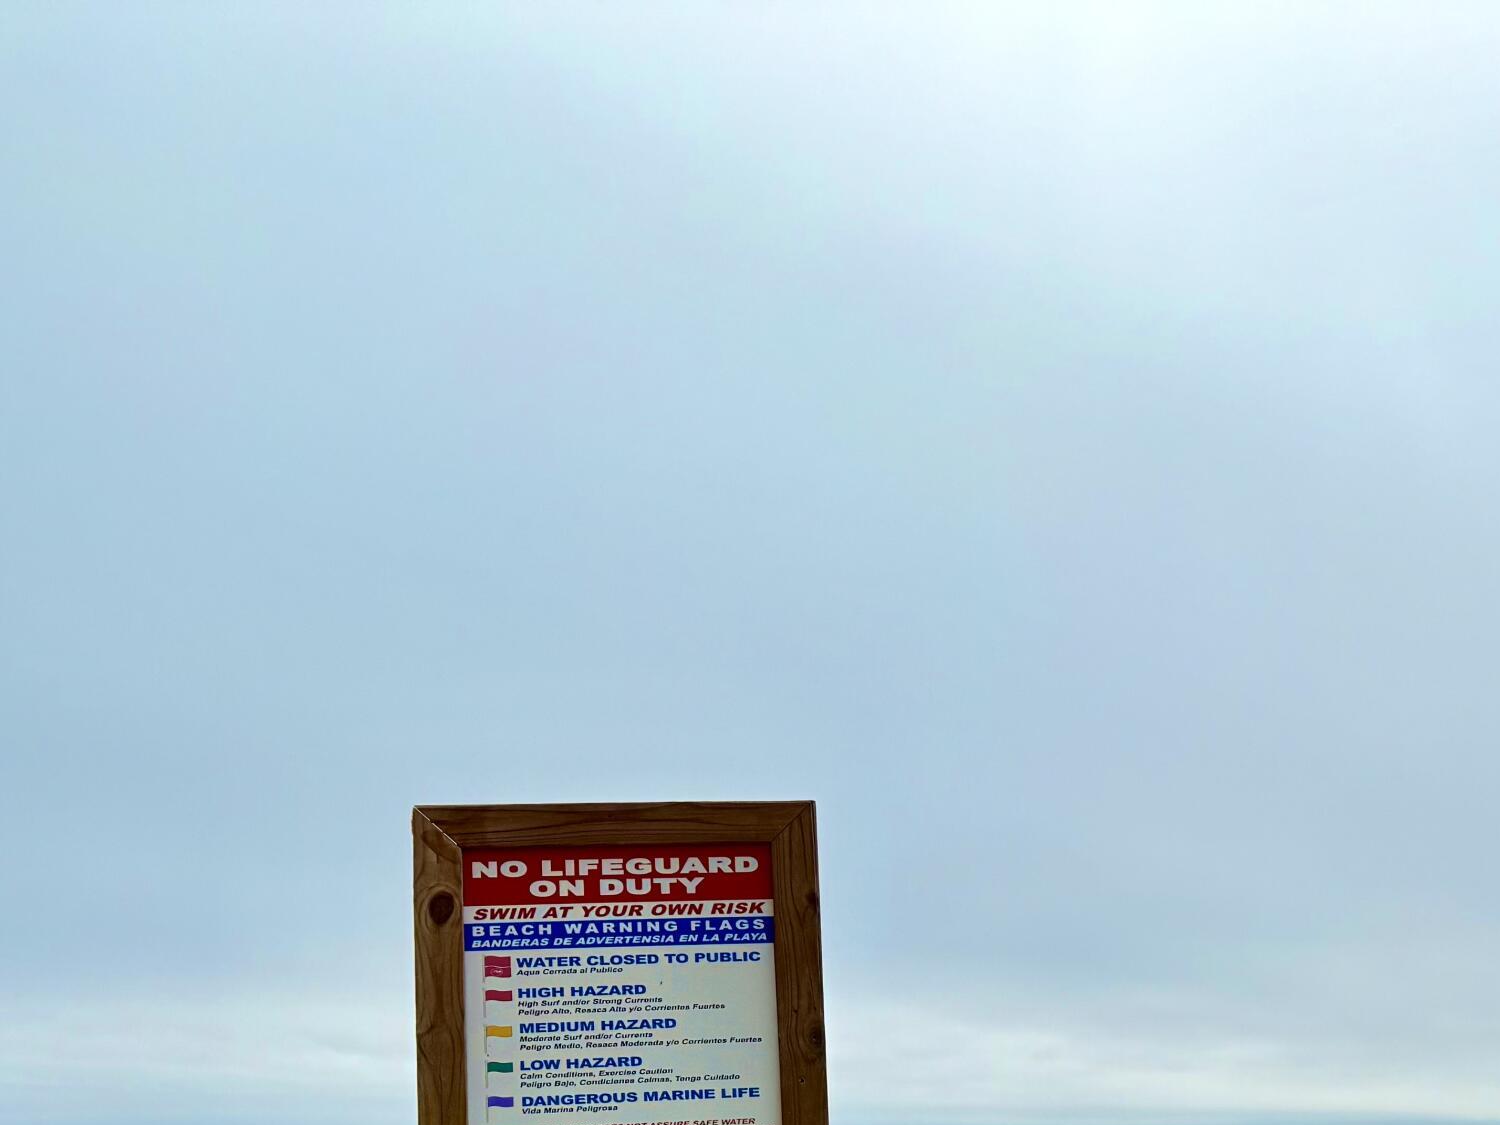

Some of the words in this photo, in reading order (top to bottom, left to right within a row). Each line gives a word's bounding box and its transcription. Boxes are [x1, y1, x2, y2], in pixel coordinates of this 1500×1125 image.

[472, 860, 528, 878] NO
[541, 856, 759, 877] LIFEGUARD
[529, 879, 585, 898] ON
[599, 876, 705, 895] DUTY
[473, 906, 537, 920] SWIM
[542, 906, 574, 919] AT
[581, 904, 644, 917] YOUR
[651, 903, 704, 916] OWN
[711, 901, 766, 914] RISK
[472, 923, 552, 937] BEACH
[564, 920, 678, 935] WARNING
[690, 918, 765, 932] FLAGS
[472, 938, 549, 948] BANDERAS
[553, 937, 574, 947] DE
[576, 934, 675, 946] ADVERTENSIA
[678, 934, 699, 943] EN
[702, 933, 720, 942] LA
[724, 932, 768, 942] PLAYA
[516, 956, 582, 969] WATER
[586, 954, 660, 966] CLOSED
[664, 953, 689, 964] TO
[694, 951, 761, 963] PUBLIC
[517, 987, 565, 999] HIGH
[571, 985, 647, 997] HAZARD
[517, 1000, 539, 1009] High
[593, 998, 622, 1006] Strong
[625, 997, 663, 1005] Currents
[518, 1008, 550, 1016] Peligro
[645, 1004, 690, 1012] Corrientes
[519, 1021, 595, 1034] MEDIUM
[601, 1018, 677, 1031] HAZARD
[519, 1035, 561, 1043] Moderate
[520, 1043, 552, 1051] Peligro
[620, 1039, 664, 1047] Moderada
[666, 1039, 679, 1047] y/o
[682, 1037, 727, 1045] Corrientes
[520, 1059, 561, 1071] LOW
[566, 1056, 643, 1069] HAZARD
[520, 1081, 552, 1089] Peligro
[704, 1073, 741, 1081] Cuidado
[521, 1092, 638, 1107] DANGEROUS
[643, 1089, 716, 1102] MARINE
[721, 1087, 760, 1099] LIFE
[576, 1105, 619, 1113] Peligrosa
[721, 1118, 756, 1125] WATER
